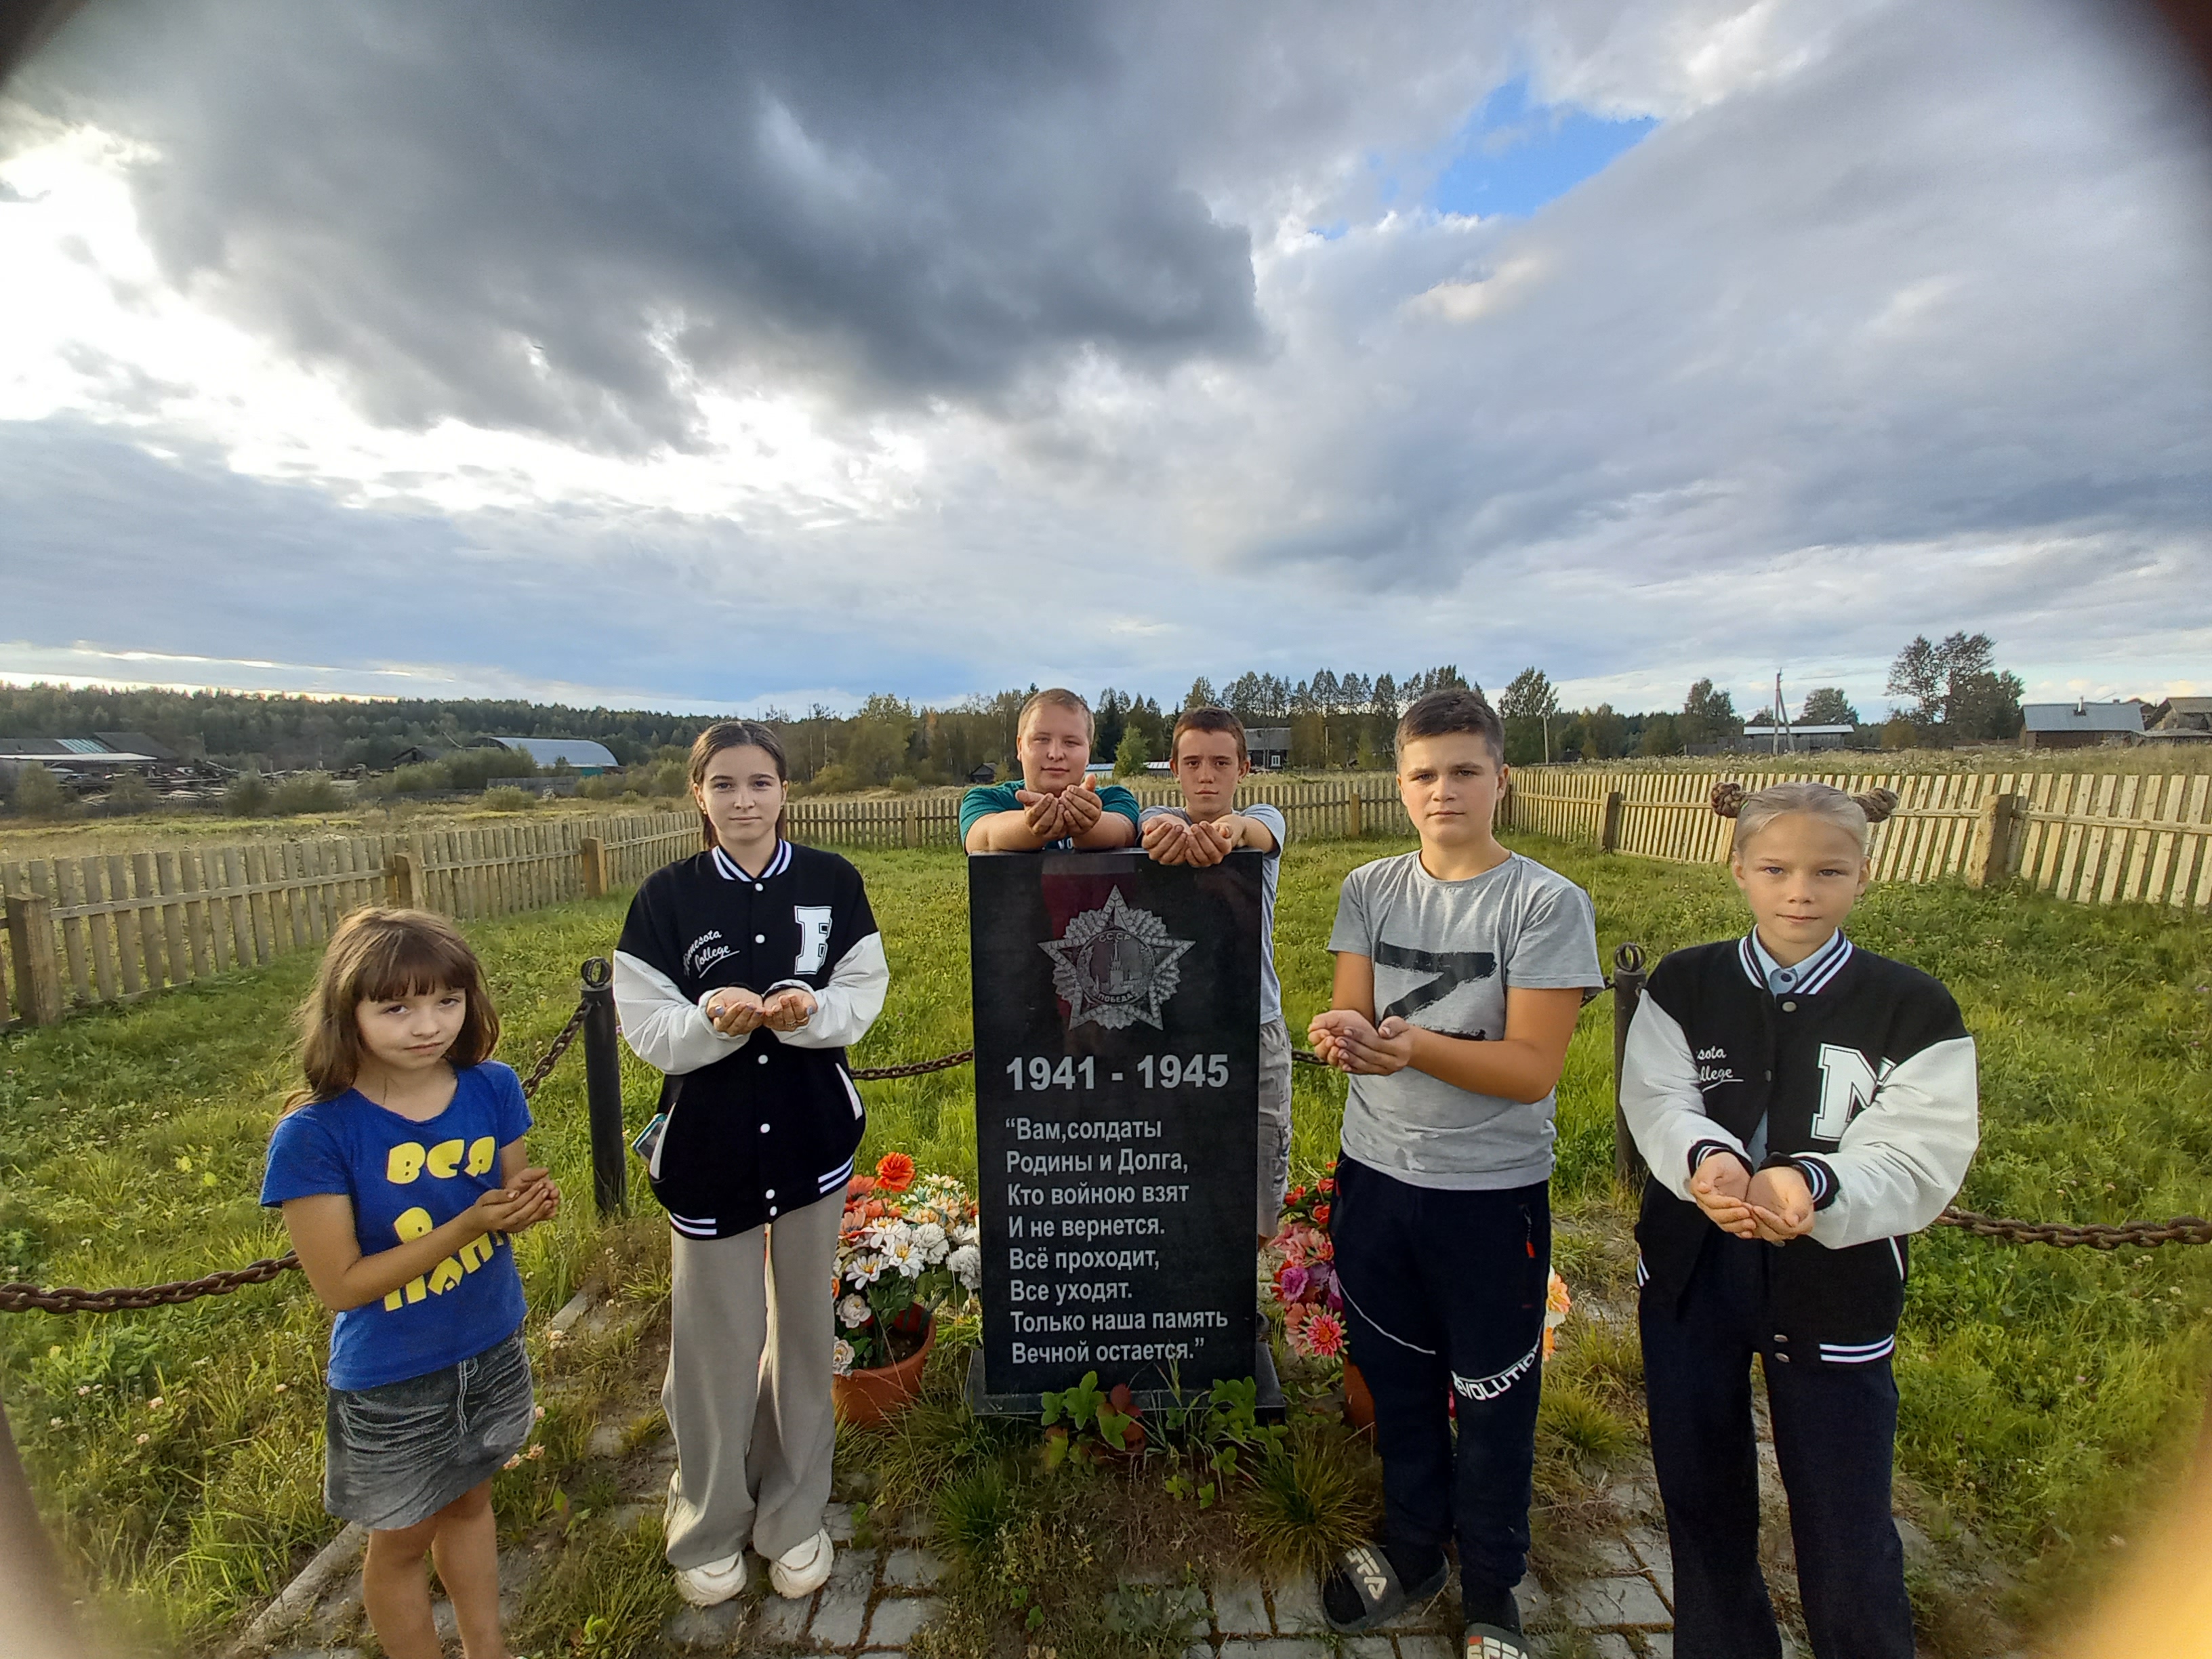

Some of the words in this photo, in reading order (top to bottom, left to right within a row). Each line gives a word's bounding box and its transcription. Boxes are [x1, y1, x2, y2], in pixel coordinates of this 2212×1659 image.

[1099, 933, 1131, 943] СССР
[695, 945, 731, 972] College
[1098, 992, 1133, 1003] ПОБЕДА
[1696, 1045, 1727, 1061] sota
[1006, 1056, 1094, 1090] 1941
[1111, 1072, 1124, 1081] -
[1137, 1054, 1229, 1088] 1945
[1699, 1065, 1734, 1081] llege
[387, 1136, 495, 1185] ВСЯ
[1006, 1151, 1092, 1176] Родины
[1099, 1154, 1112, 1171] и
[1118, 1148, 1188, 1174] Долга,
[1008, 1183, 1044, 1206] Кто
[1051, 1181, 1135, 1205] войною
[1143, 1185, 1189, 1202] взят
[1008, 1216, 1023, 1238] И
[1030, 1220, 1055, 1237] не
[1062, 1218, 1165, 1242] вернется.
[1010, 1246, 1048, 1269] Всё
[1055, 1250, 1160, 1274] проходит,
[1010, 1279, 1049, 1301] Все
[1055, 1282, 1132, 1306] уходят.
[1010, 1311, 1085, 1332] Только
[1092, 1313, 1146, 1330] наша
[1153, 1311, 1228, 1329] память
[1012, 1340, 1089, 1364] Вечной
